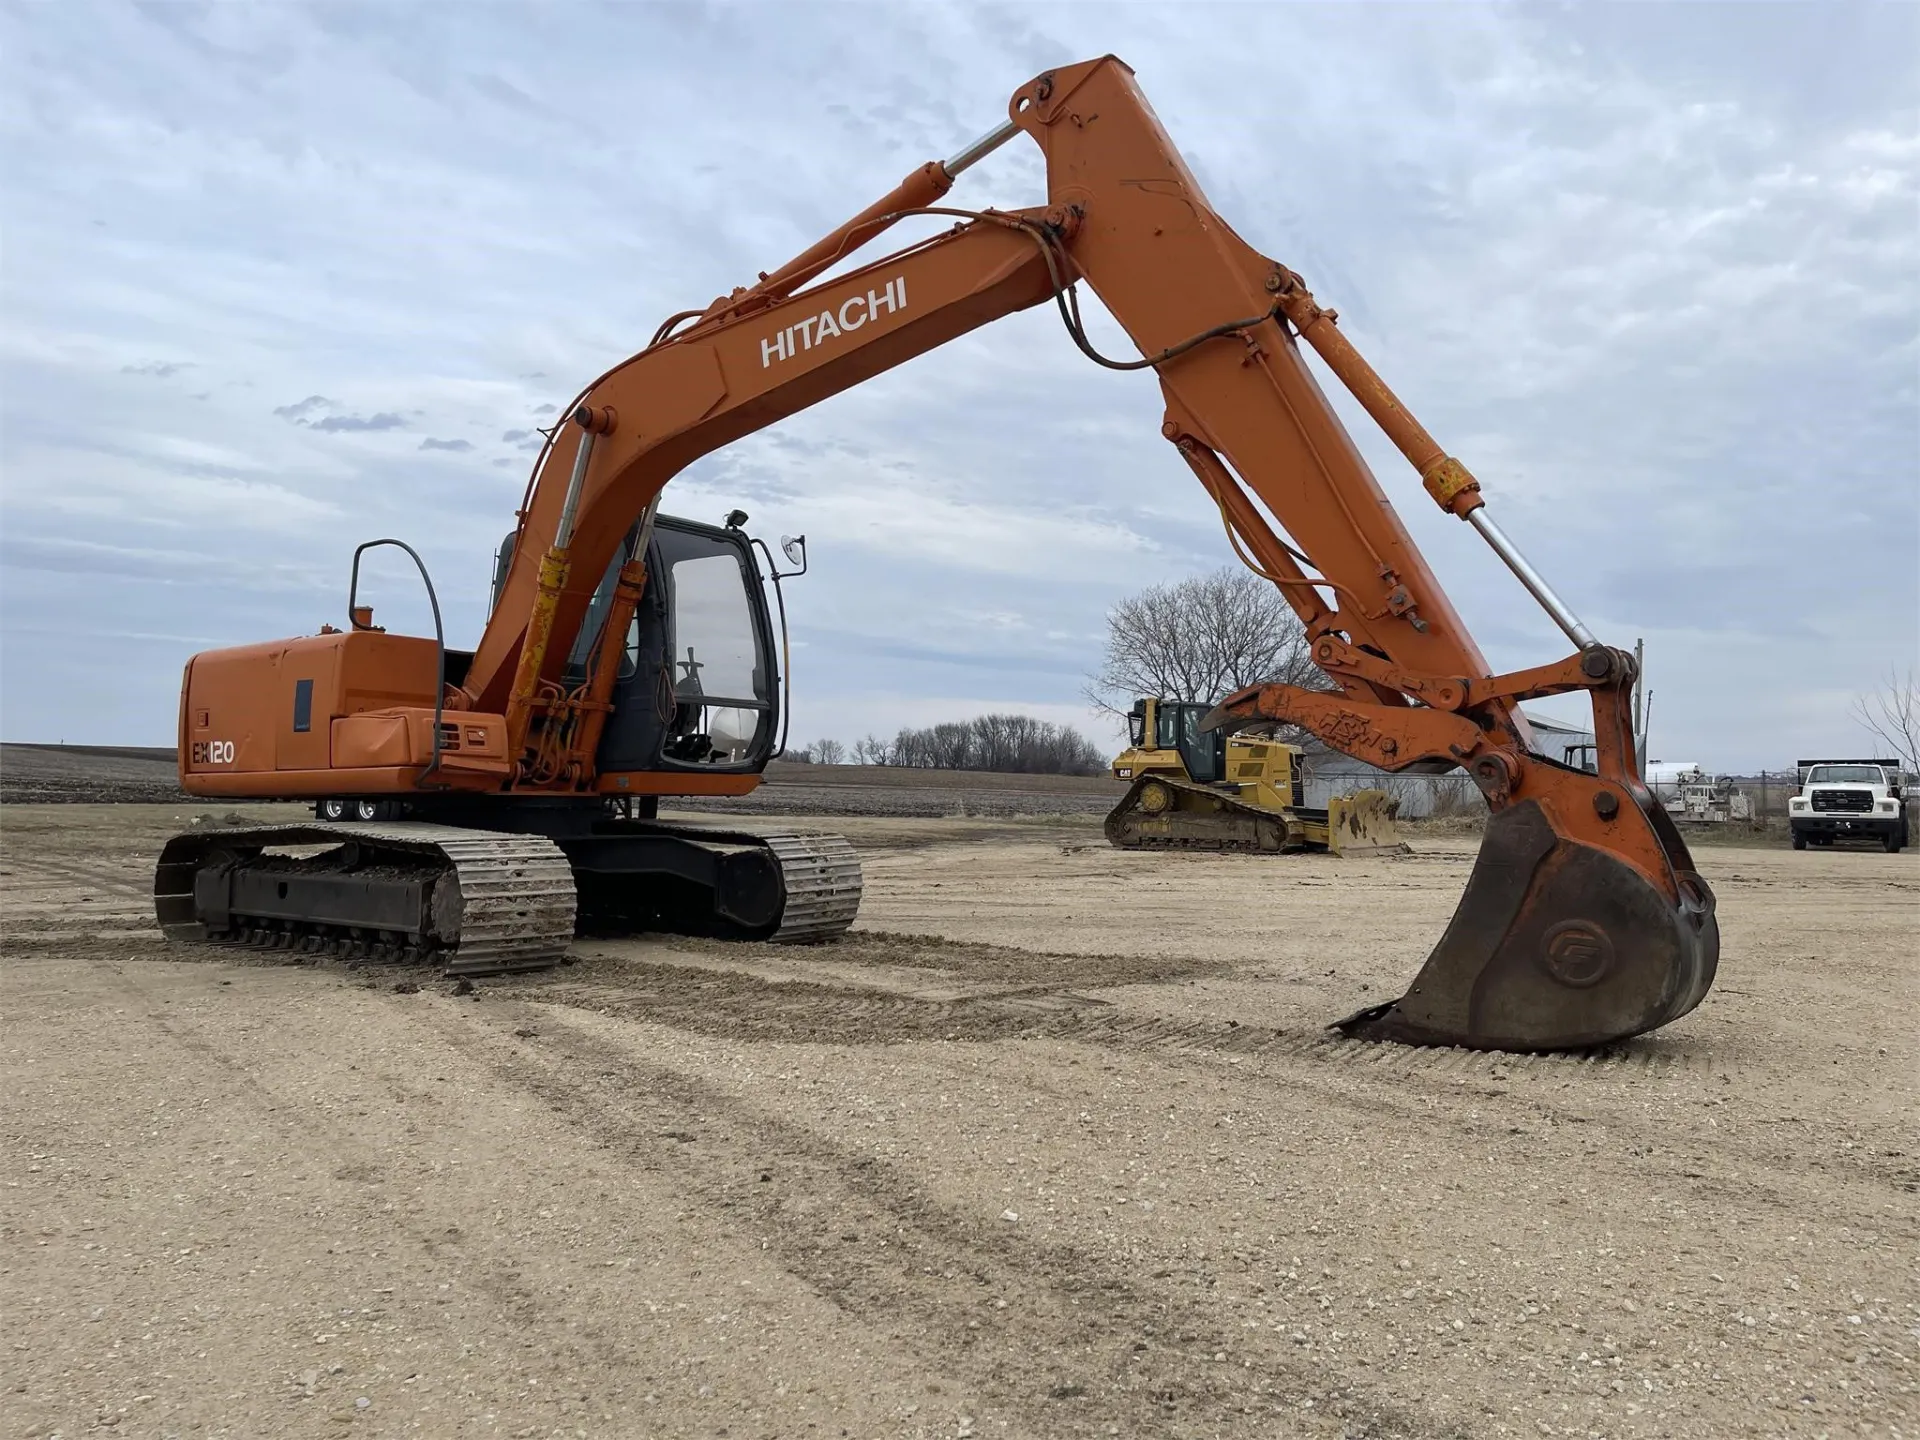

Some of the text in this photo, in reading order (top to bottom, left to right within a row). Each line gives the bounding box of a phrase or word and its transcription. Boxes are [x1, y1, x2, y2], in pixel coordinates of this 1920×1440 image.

[760, 276, 907, 368] HITACHI
[193, 741, 234, 763] EX120
[1119, 769, 1131, 777] CAT
